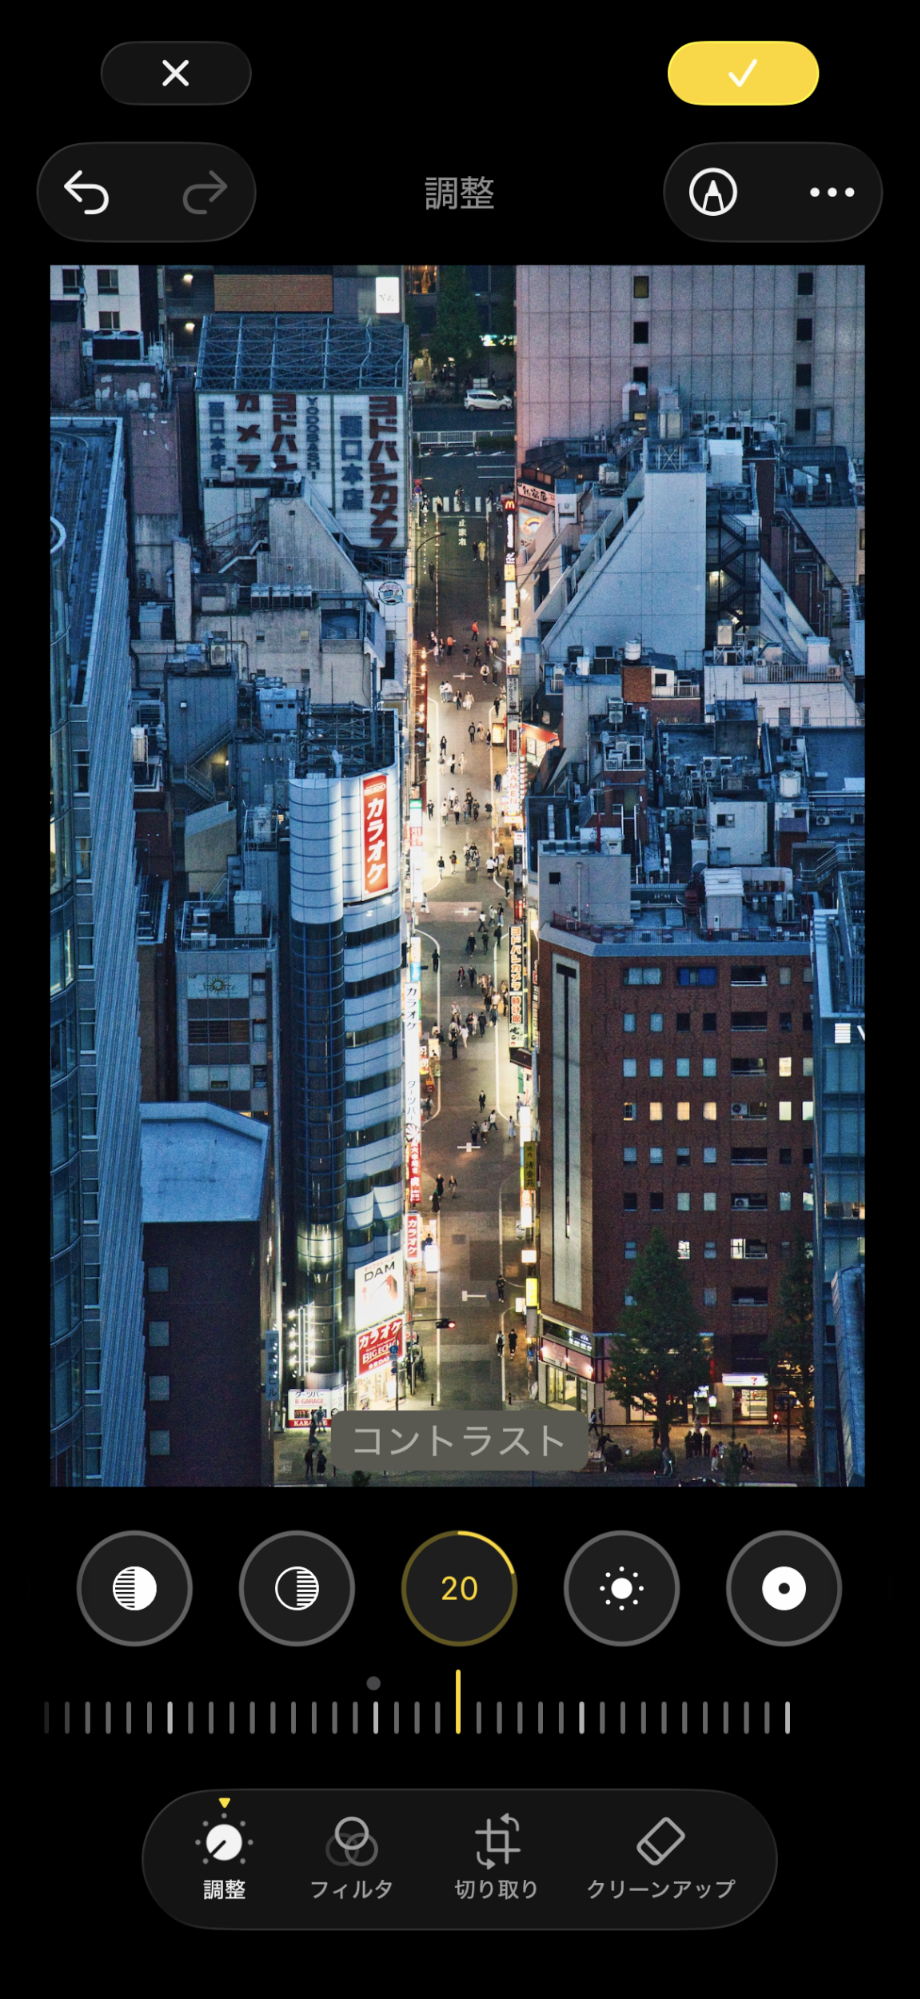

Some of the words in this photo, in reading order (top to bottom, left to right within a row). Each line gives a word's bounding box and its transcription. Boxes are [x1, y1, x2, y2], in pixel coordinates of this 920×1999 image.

[235, 394, 261, 473] カメラ
[271, 394, 299, 473] ヨドバシ
[305, 396, 321, 480] YODOBASHI
[368, 396, 399, 548] ヨドバシカメラ
[510, 766, 518, 805] RAMEN
[367, 798, 386, 885] カラオケ
[510, 926, 522, 991] ヨドバシカメラ
[406, 988, 417, 1030] カラオケ
[407, 1219, 417, 1254] カラオケ
[364, 1261, 395, 1282] DAM
[359, 1321, 403, 1350] カラオケ
[362, 1350, 378, 1365] BIG
